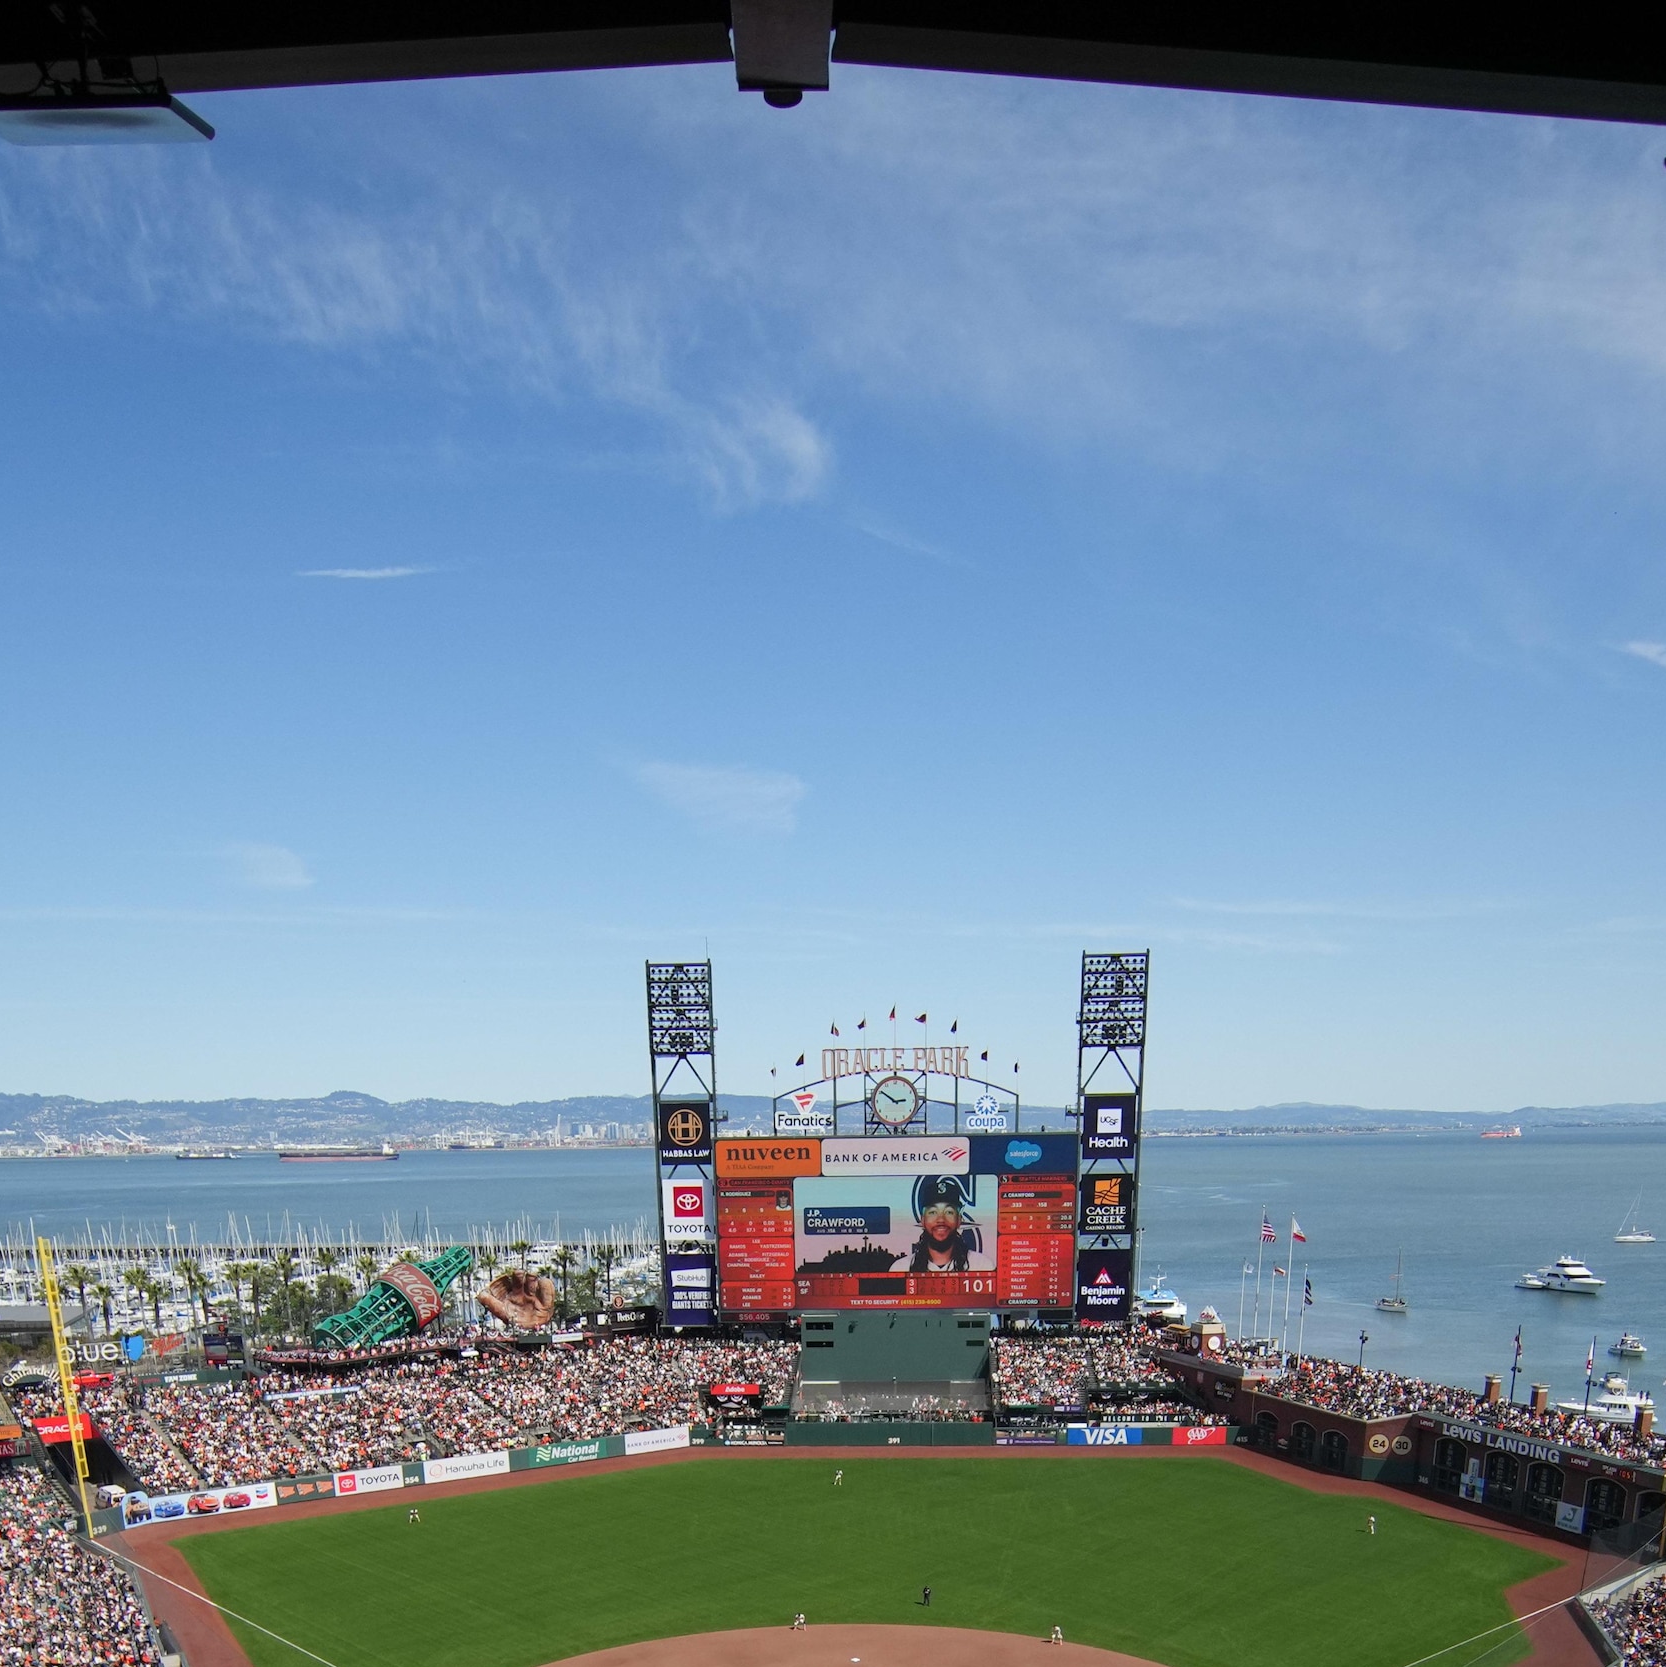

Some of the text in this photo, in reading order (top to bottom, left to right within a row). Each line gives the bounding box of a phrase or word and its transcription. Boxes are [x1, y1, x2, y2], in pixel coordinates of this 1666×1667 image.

[822, 1046, 970, 1080] ORACLE PARK
[778, 1114, 833, 1126] Fanatics
[968, 1116, 1004, 1130] coupa
[1089, 1137, 1128, 1148] Health
[726, 1147, 810, 1160] nuveen
[826, 1152, 938, 1162] BANK OF AMERICA
[1010, 1150, 1038, 1158] salesforce
[1086, 1206, 1126, 1215] CACHE
[808, 1218, 865, 1228] CRAWFORD
[1087, 1216, 1124, 1224] CREEK
[667, 1224, 712, 1233] TOYOTA
[676, 1274, 706, 1282] StubHub
[974, 1280, 983, 1292] 0
[986, 1280, 993, 1292] 1
[1081, 1286, 1126, 1298] Benjamin
[672, 1301, 692, 1309] GIANTS
[1087, 1296, 1118, 1304] Moore
[37, 1423, 84, 1435] ORACE
[1082, 1428, 1128, 1445] VISA
[1188, 1429, 1206, 1440] AAA
[651, 1437, 676, 1446] AMERICA
[1396, 1441, 1408, 1449] 30
[552, 1441, 600, 1459] National
[1486, 1434, 1560, 1464] LANDING
[580, 1454, 597, 1462] Rental
[445, 1458, 505, 1474] Hanwha Life
[360, 1473, 400, 1485] TOYOTA
[405, 1476, 420, 1484] 354
[93, 1524, 107, 1534] 339
